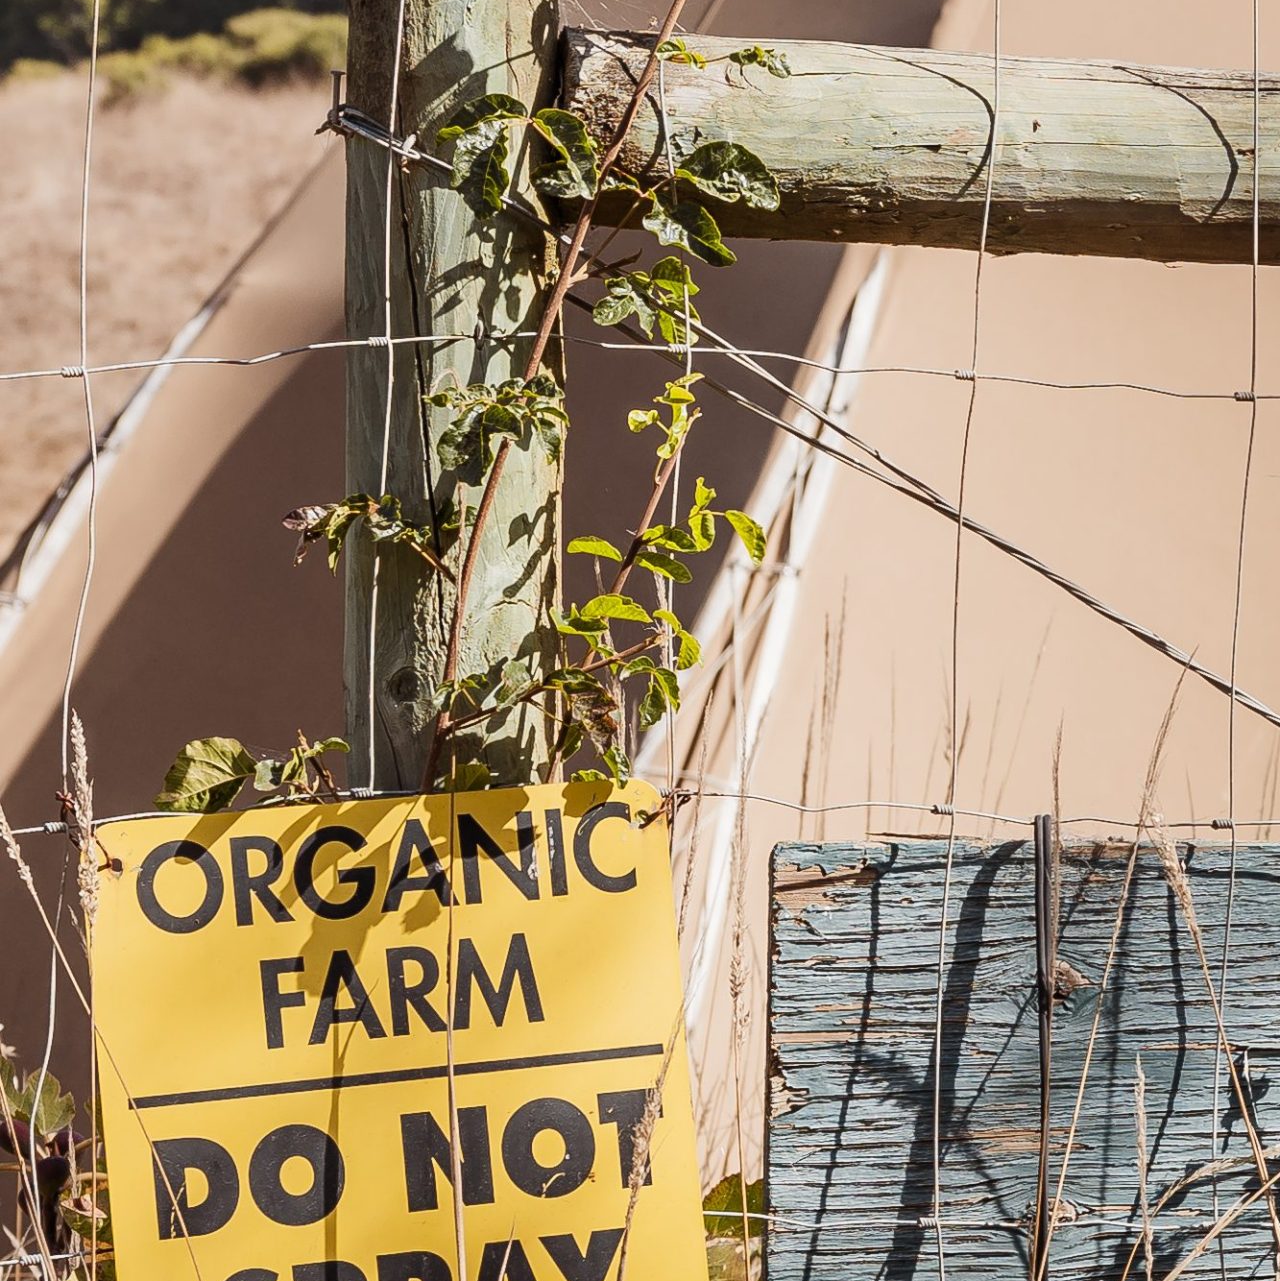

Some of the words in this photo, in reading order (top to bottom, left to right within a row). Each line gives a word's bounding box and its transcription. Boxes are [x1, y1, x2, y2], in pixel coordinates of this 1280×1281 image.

[136, 801, 638, 934] ORGANIC
[259, 933, 545, 1049] FARM
[152, 1123, 346, 1241] DO
[399, 1088, 665, 1213] NOT
